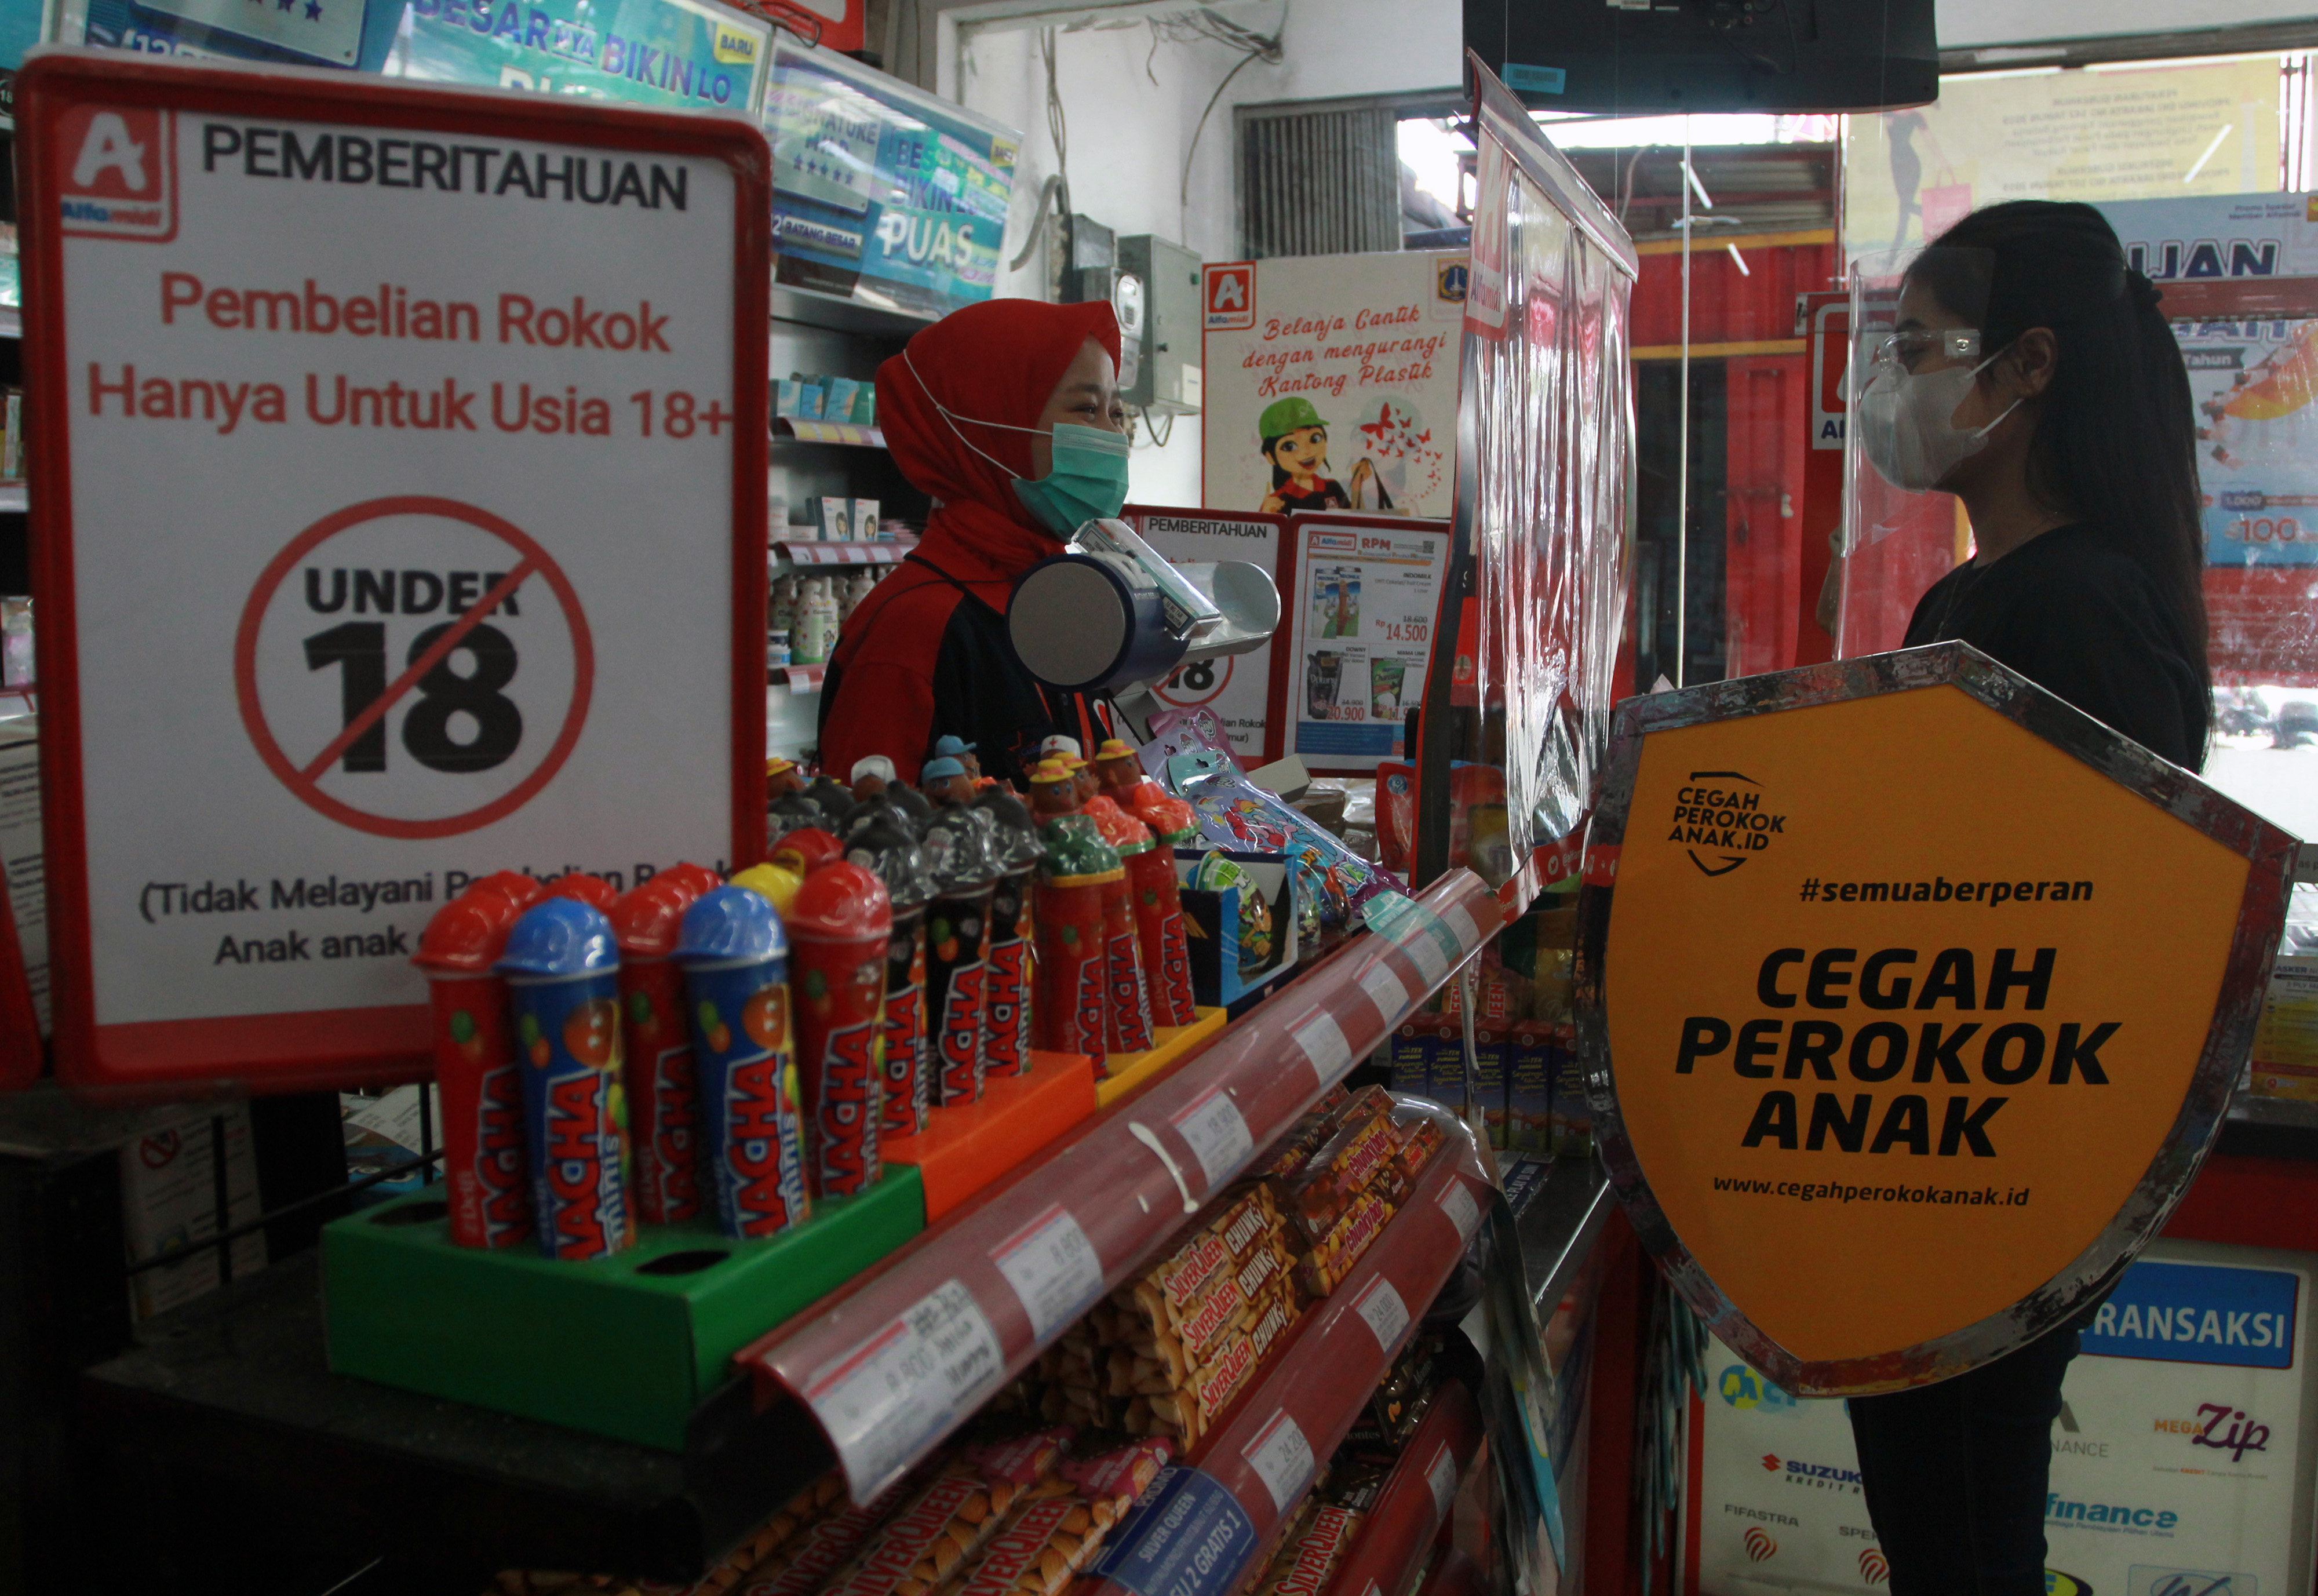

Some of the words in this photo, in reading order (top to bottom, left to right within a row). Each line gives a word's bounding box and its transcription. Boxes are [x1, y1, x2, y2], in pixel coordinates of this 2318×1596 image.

[602, 32, 694, 96] BIKIN
[698, 67, 731, 105] LO
[720, 34, 753, 56] BARU
[203, 123, 688, 211] PEMBERITAHUAN
[883, 213, 975, 267] PUAS
[161, 271, 479, 343] Pembelian
[499, 293, 671, 352] Rokok
[1207, 314, 1249, 325] Alfamidi
[1262, 316, 1345, 342] Belanja
[1355, 304, 1421, 330] Cantik
[1241, 348, 1314, 375] dengan
[1324, 331, 1448, 366] mengurangi
[88, 362, 286, 435] Hanya
[305, 373, 478, 431] Untuk
[491, 382, 611, 436] Usia
[630, 389, 732, 439] 18+
[1258, 371, 1347, 398] Kantong
[1358, 361, 1434, 387] Plastik
[1149, 517, 1267, 538] PEMBERITAHUAN
[1321, 537, 1353, 546] Alfamidi
[1361, 538, 1391, 551] RPM
[304, 567, 520, 616] UNDER
[1376, 620, 1386, 628] Rp
[1386, 624, 1428, 642] 14.500
[302, 621, 523, 773] 18
[1326, 707, 1365, 721] 20.900
[1673, 806, 1787, 833] PEROKOK
[1678, 787, 1760, 811] CEGAH
[1668, 825, 1769, 851] ANAK.ID
[139, 871, 260, 923] (Tidak
[271, 872, 434, 913] Melayani
[1799, 876, 2094, 909] #semuaberperan
[213, 930, 311, 966] Anak
[320, 925, 408, 959] anak
[1756, 946, 2057, 1011] CEGAH
[1675, 1016, 2123, 1086] PEROKOK
[1740, 1089, 2010, 1158] ANAK
[1712, 1173, 2031, 1207] www.cegahperokokanak.id
[1224, 1202, 1269, 1256] CHUNKY
[1164, 1234, 1225, 1306] SILVERQUEEN
[1237, 1245, 1280, 1298] CHUNKY
[1182, 1278, 1240, 1353] SILVERQUEEN
[1252, 1296, 1288, 1357] CHUNKY
[1200, 1336, 1253, 1418] SILVERQUEEN
[2051, 1440, 2109, 1458] NANCE
[2154, 1419, 2203, 1435] MEGA
[2192, 1402, 2270, 1463] Zip
[1785, 1474, 1845, 1492] KREDIT
[1138, 1525, 1172, 1564] SILVER
[1164, 1492, 1196, 1529] QUEEN
[1725, 1504, 1799, 1527] FIFASTRA
[1185, 1567, 1202, 1589] 2
[1194, 1518, 1234, 1576] GRATIS
[1226, 1509, 1241, 1530] 1
